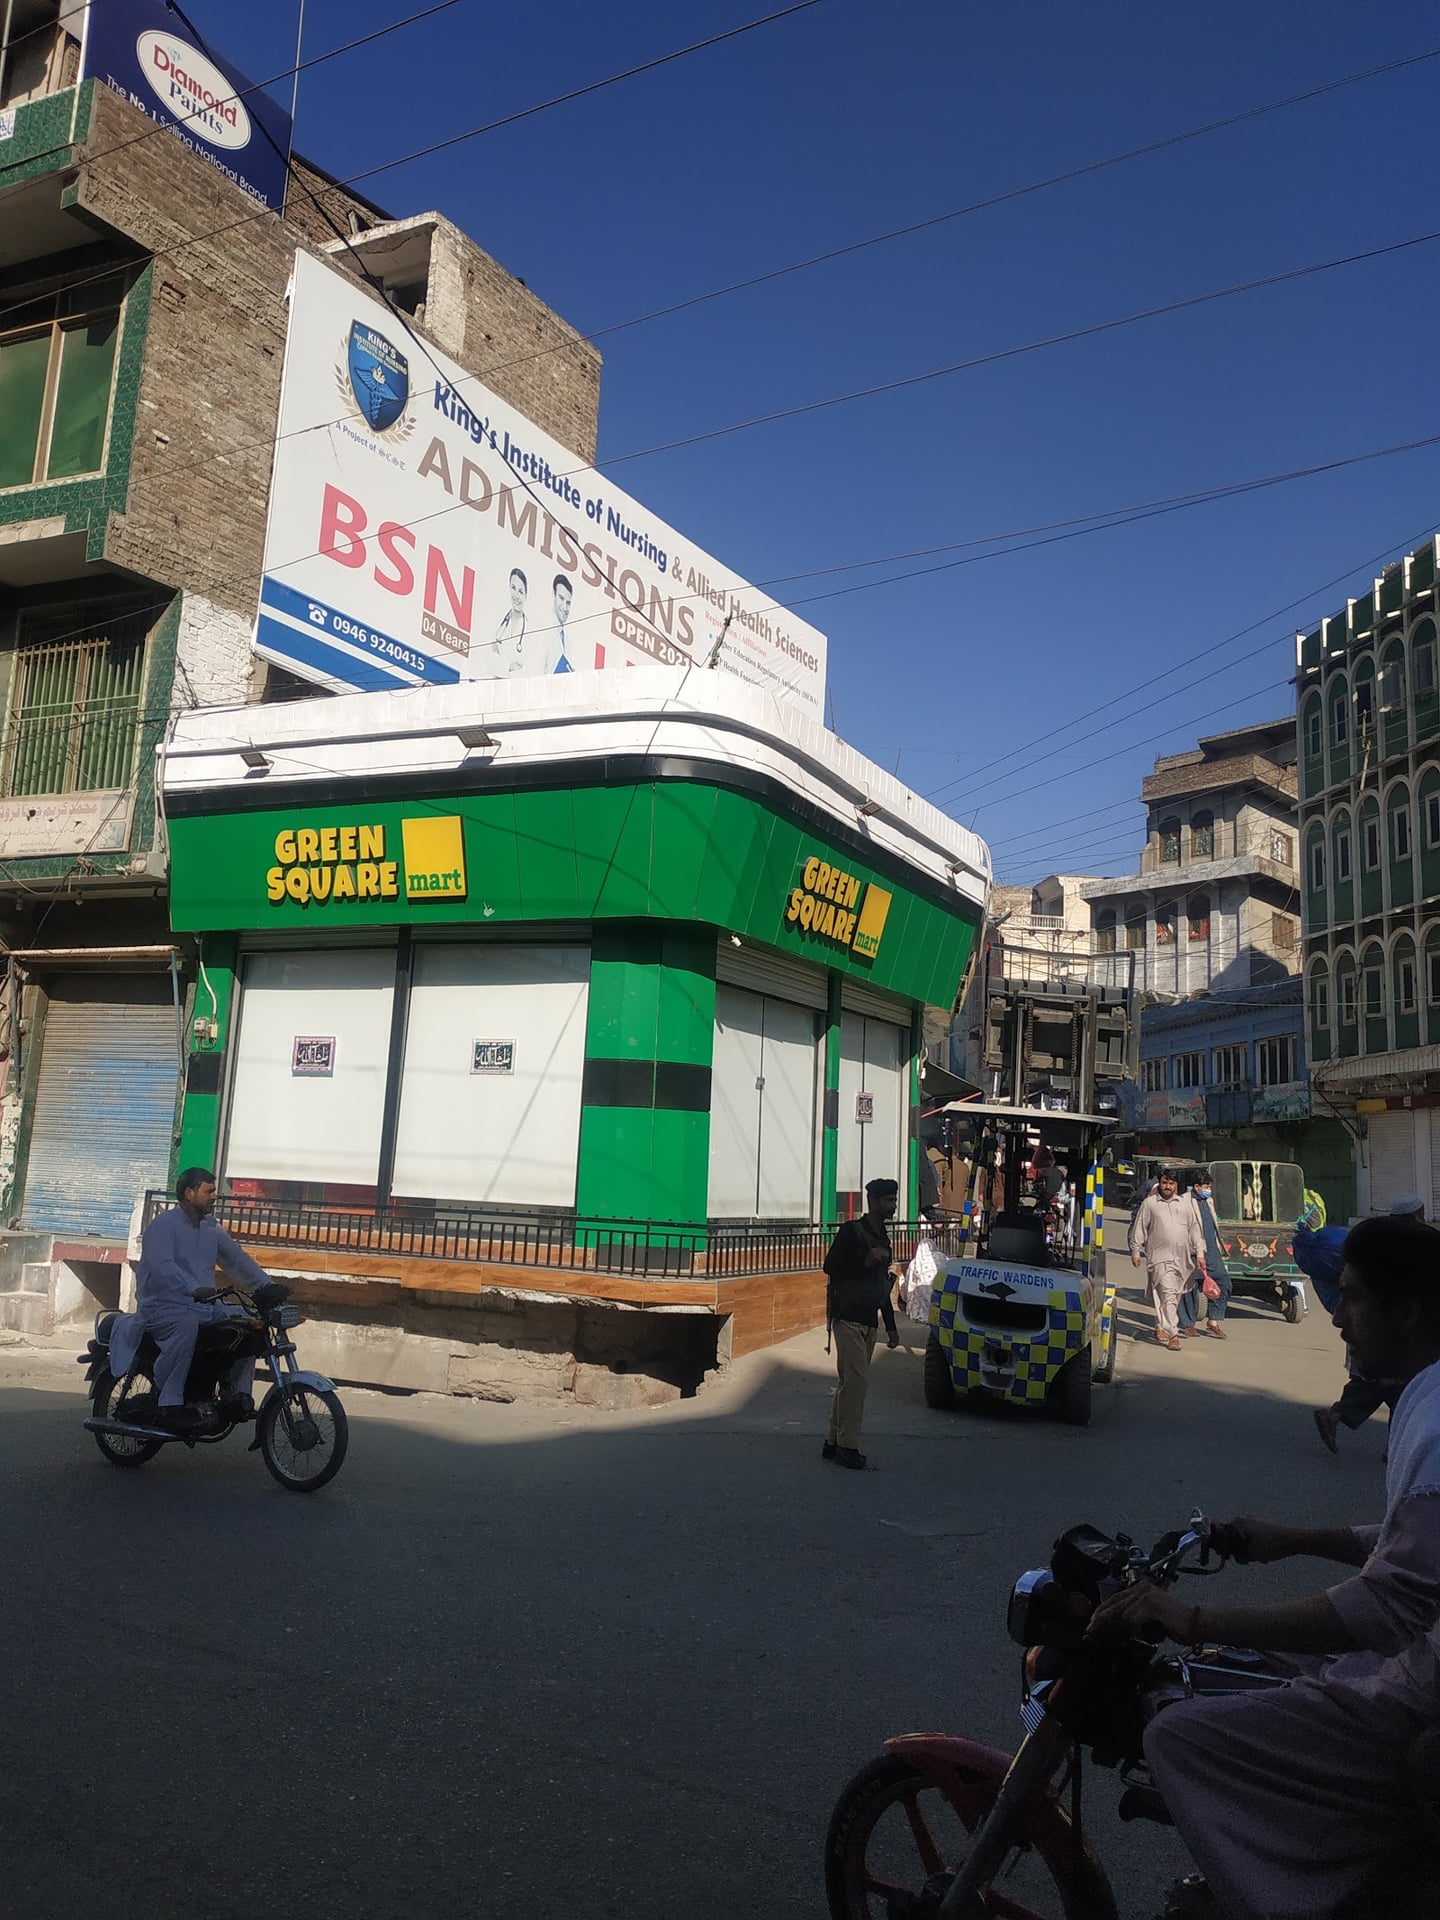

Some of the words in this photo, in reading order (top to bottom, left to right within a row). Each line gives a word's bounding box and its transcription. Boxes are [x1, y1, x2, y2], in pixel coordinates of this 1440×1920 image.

[152, 44, 238, 128] Diamond
[168, 81, 224, 135] Paints
[106, 73, 127, 97] The
[159, 115, 193, 152] Selling
[195, 145, 238, 183] National
[239, 175, 268, 205] Brand
[367, 331, 397, 359] KING'S
[335, 421, 341, 431] A
[342, 424, 368, 448] Project
[368, 444, 377, 452] of
[417, 436, 695, 646] ADMISSIONS
[433, 379, 497, 449] King's
[503, 431, 581, 510] Institute
[586, 499, 603, 524] of
[607, 506, 667, 573] Nursing
[671, 556, 682, 583] &
[686, 566, 726, 614] Allied
[730, 595, 772, 643] Health
[775, 626, 818, 673] Sciences
[318, 482, 476, 634] BSN
[333, 615, 367, 644] 0946
[370, 634, 425, 672] 9240415
[422, 616, 437, 637] 04
[438, 622, 470, 653] Years
[615, 616, 655, 653] OPEN
[275, 824, 385, 864] GREEN
[266, 862, 398, 904] SQUARE
[408, 869, 463, 892] mart
[804, 857, 861, 909] GREEN
[787, 888, 857, 945] SQUARE
[855, 932, 879, 953] mart
[960, 1266, 999, 1281] TRAFFIC
[1003, 1271, 1054, 1289] WARDENS
